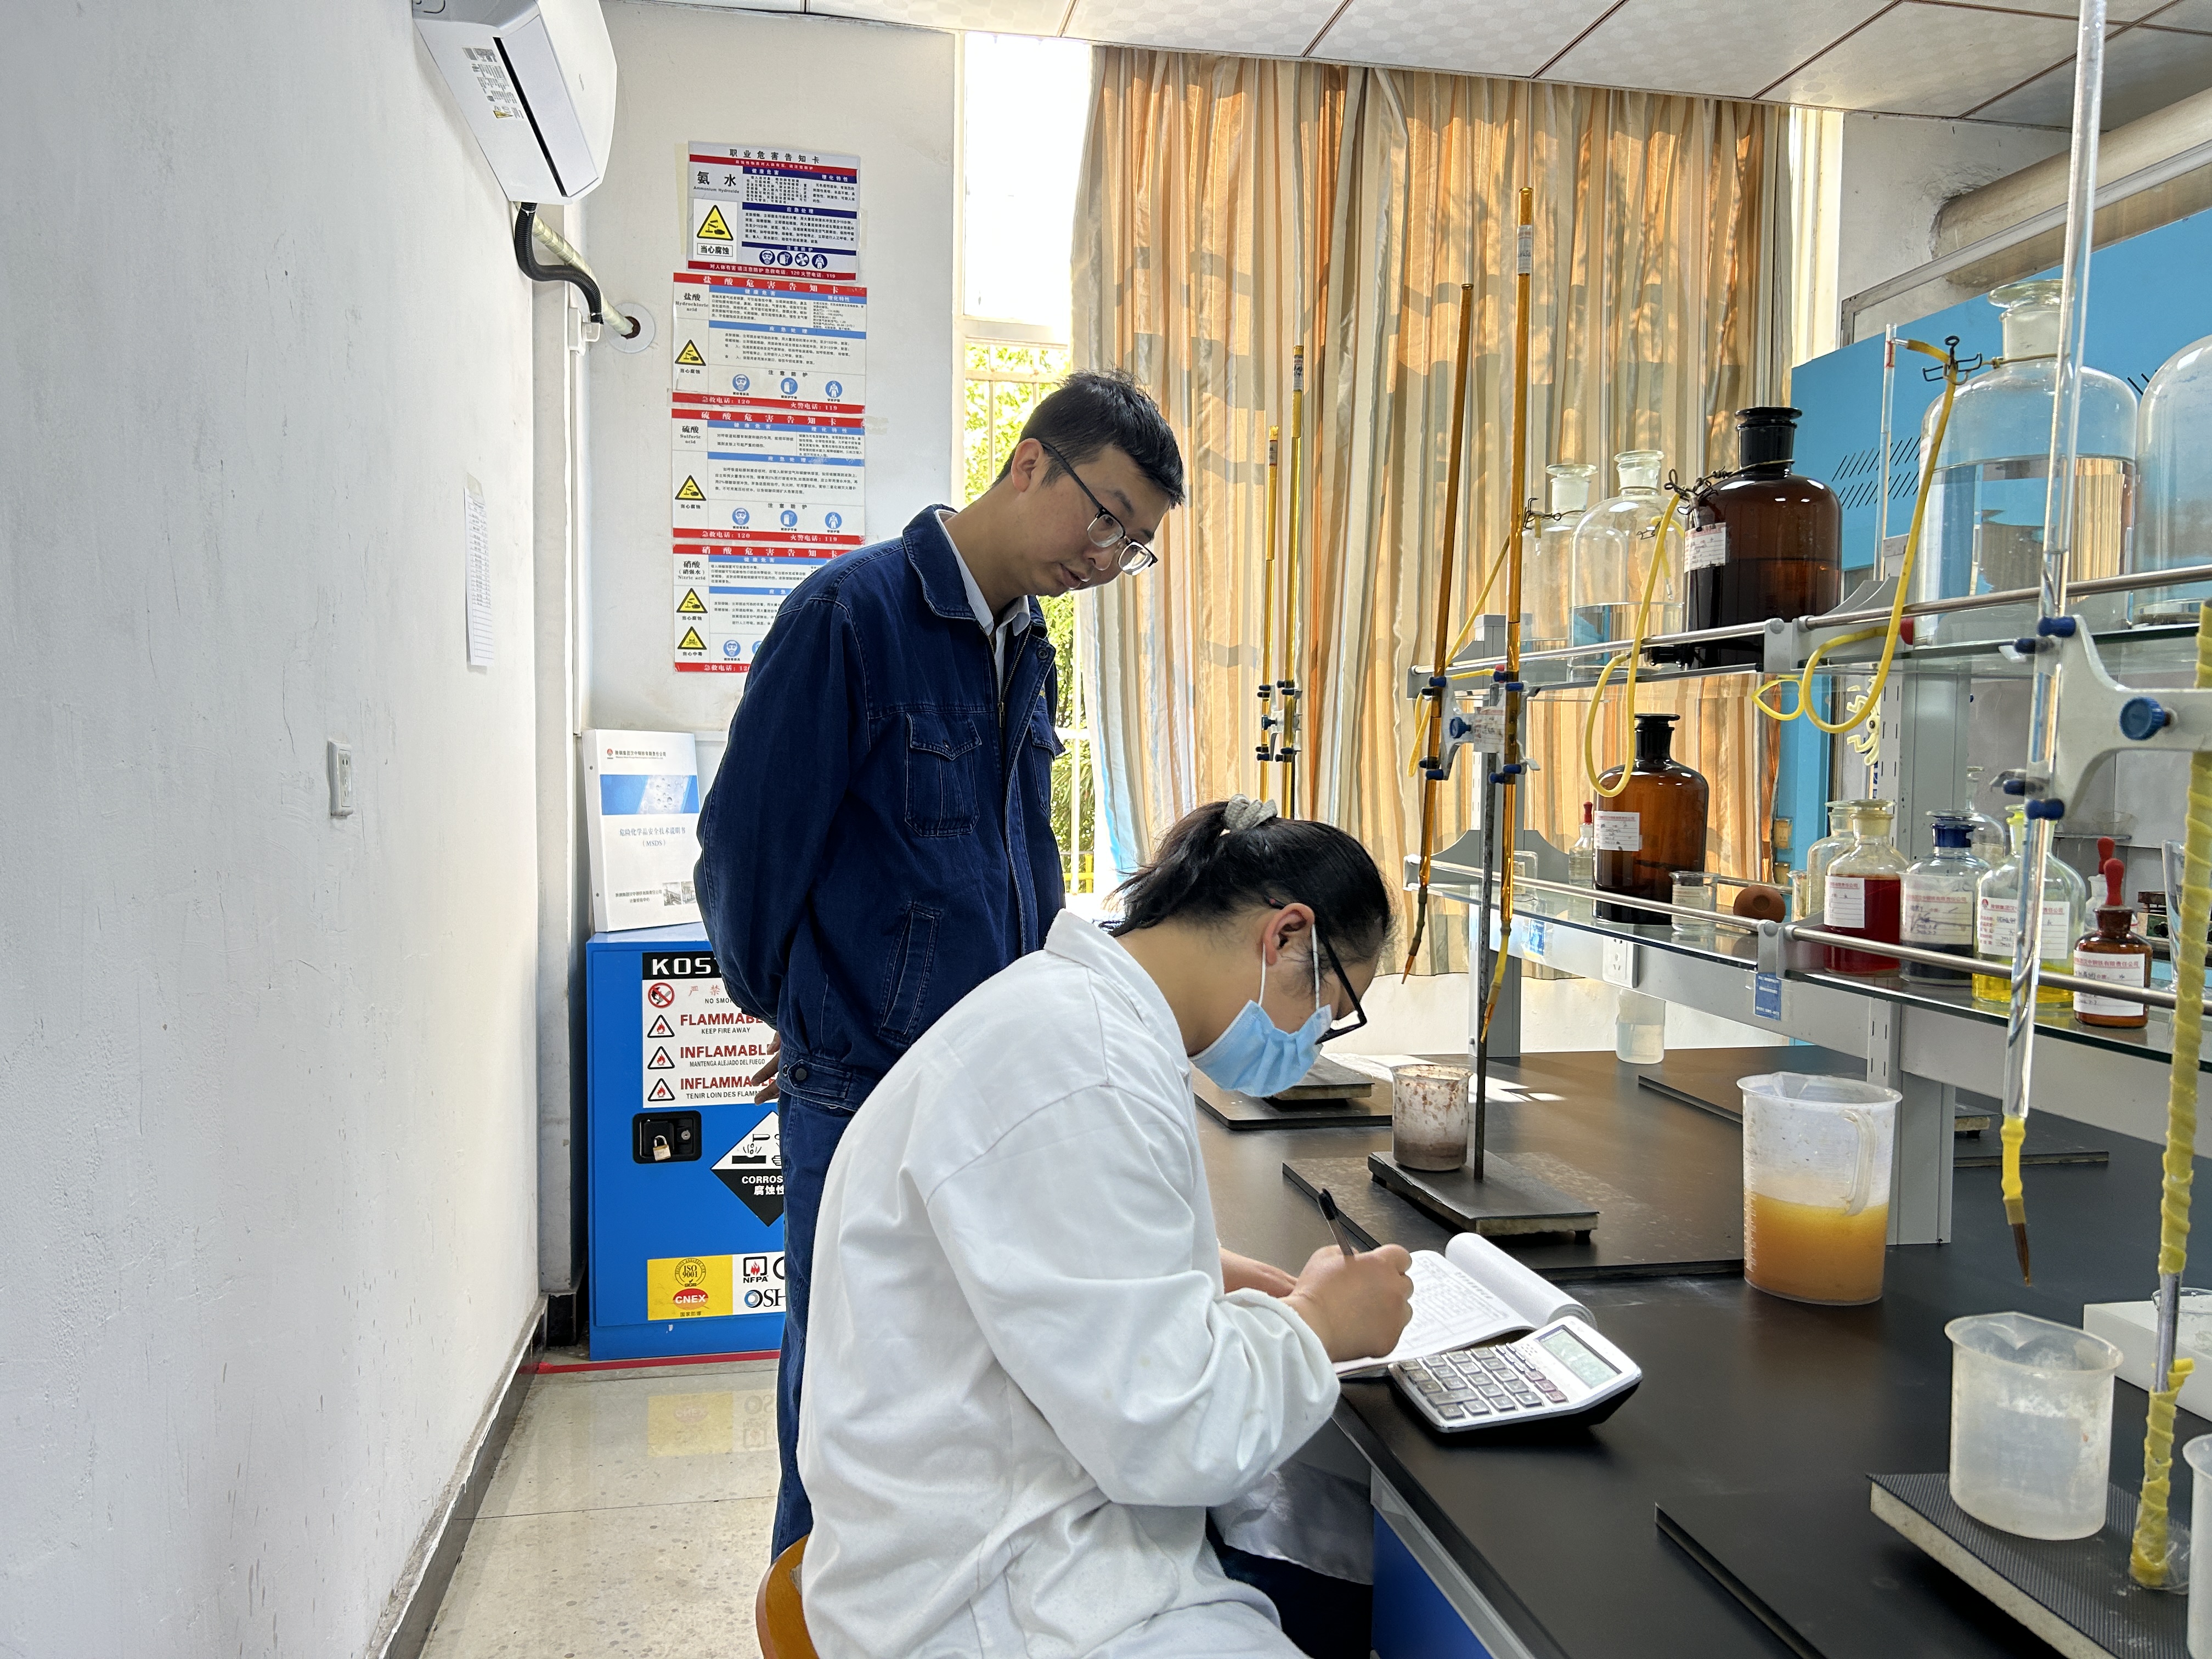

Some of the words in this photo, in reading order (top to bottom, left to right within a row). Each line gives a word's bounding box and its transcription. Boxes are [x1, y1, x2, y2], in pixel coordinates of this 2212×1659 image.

[730, 149, 819, 164] 职业危害告知卡
[697, 171, 736, 187] 氨水
[821, 174, 848, 182] 理化特性
[701, 245, 730, 255] 当心腐蚀
[765, 267, 799, 276] 急救电话：120
[801, 269, 836, 279] 火警电话：119
[703, 275, 838, 294] 盐酸危害告知卡
[684, 292, 701, 301] 盐酸
[702, 397, 750, 405] 急救电话：120
[790, 402, 837, 411] 火警电话：119
[701, 411, 837, 426] 硫酸危害告知卡
[682, 425, 699, 434] 硫酸
[702, 531, 751, 539] 急救电话：120
[790, 534, 837, 542] 火警电话：119
[702, 546, 838, 558] 硝酸危害告知卡
[620, 827, 686, 837] 危险化学品安全技术说明书
[652, 957, 722, 975] KOS
[689, 985, 720, 996] 严禁
[754, 1185, 785, 1195] 腐蚀性
[675, 1294, 707, 1304] CNEX
